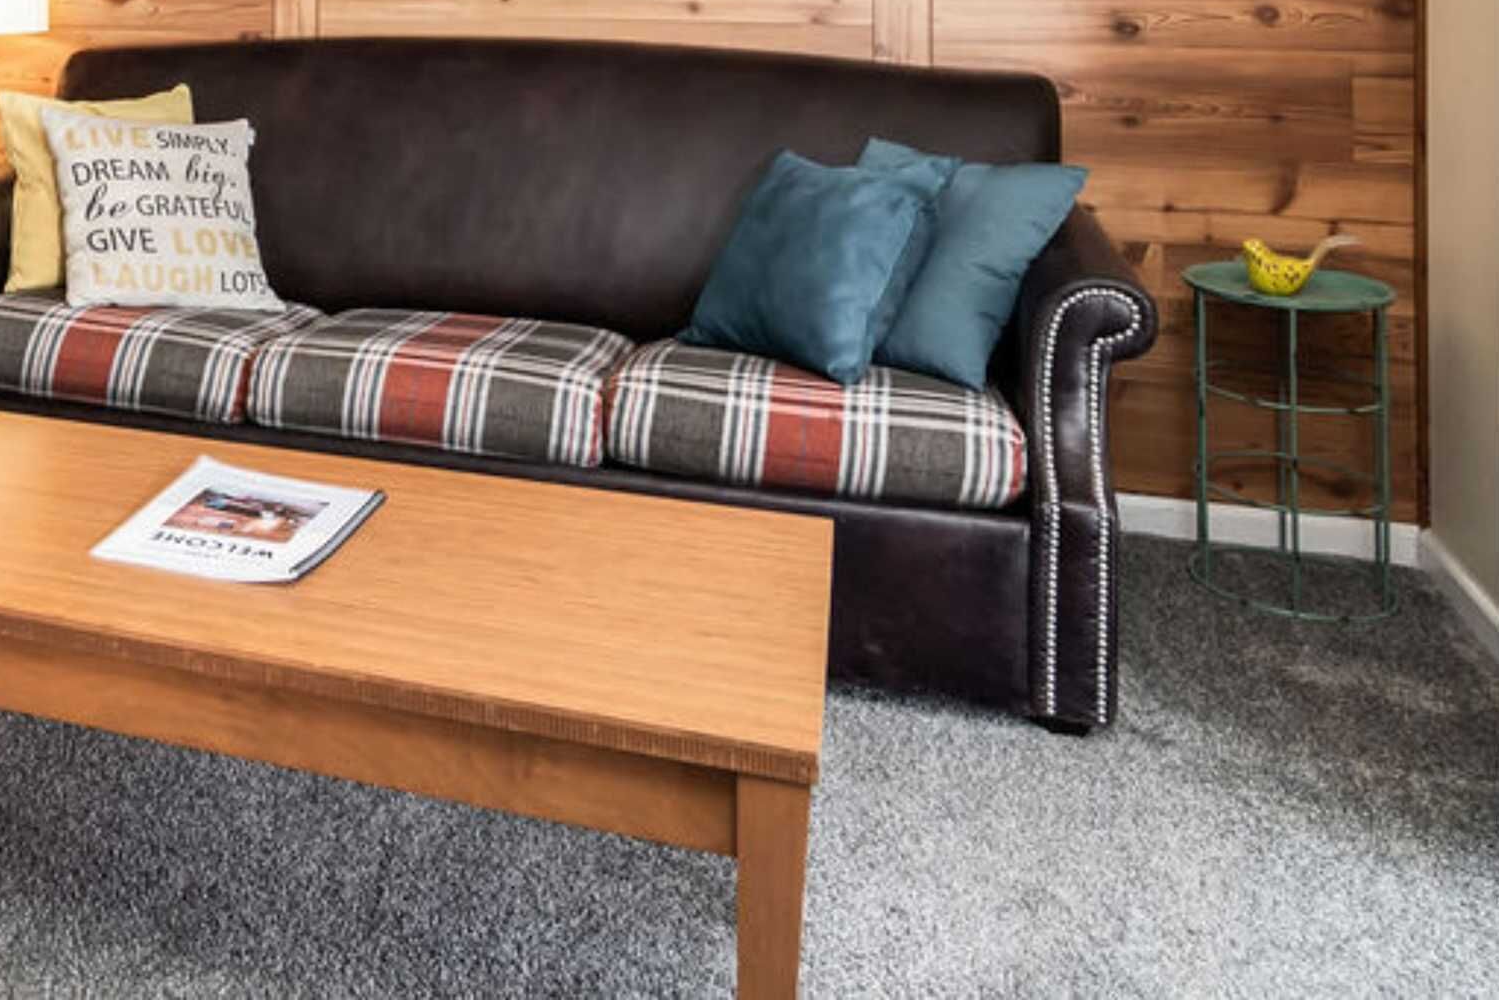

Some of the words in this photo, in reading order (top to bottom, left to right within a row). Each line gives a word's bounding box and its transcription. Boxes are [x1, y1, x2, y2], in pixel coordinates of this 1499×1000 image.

[65, 127, 151, 150] LIVE
[71, 159, 170, 186] DREAM
[84, 183, 134, 222] be
[86, 228, 158, 253] GIVE
[171, 228, 258, 259] LOVE
[91, 262, 214, 294] LAUGH
